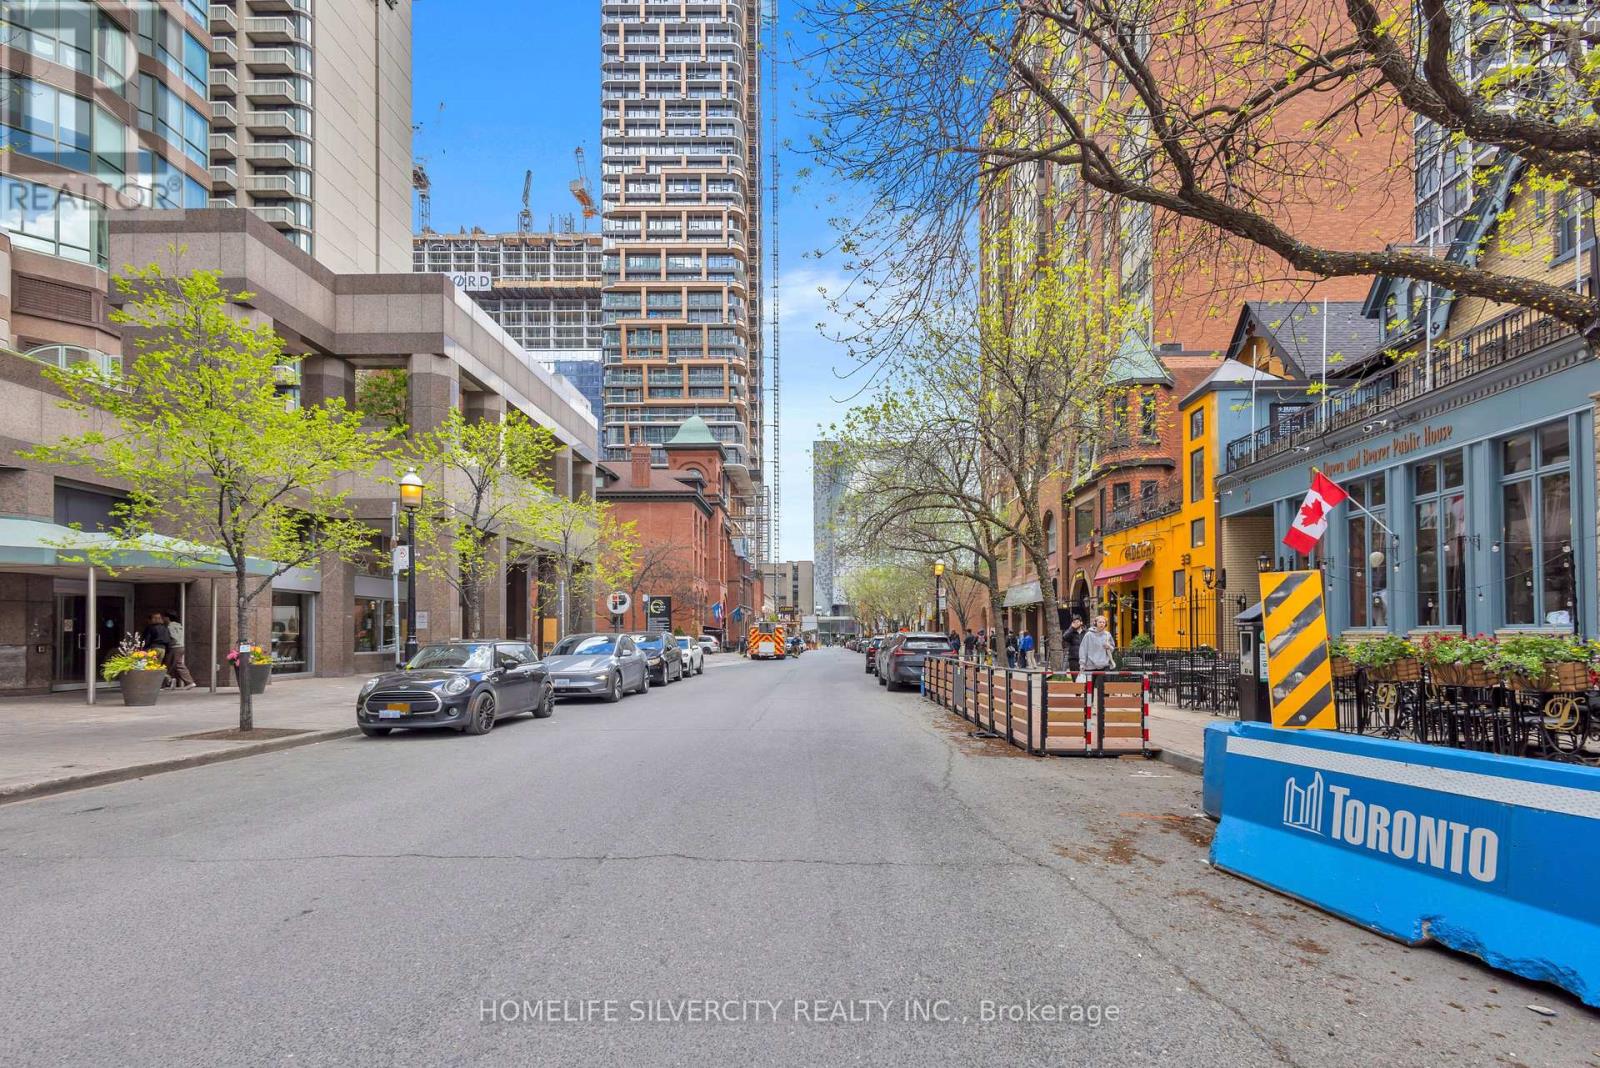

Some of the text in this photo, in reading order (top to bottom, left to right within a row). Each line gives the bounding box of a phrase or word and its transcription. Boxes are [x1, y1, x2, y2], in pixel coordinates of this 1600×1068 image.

[1347, 449, 1361, 472] and
[1363, 447, 1390, 466] Beaver
[1392, 432, 1421, 457] Public
[1424, 424, 1453, 446] House
[1329, 785, 1499, 883] TORONTO
